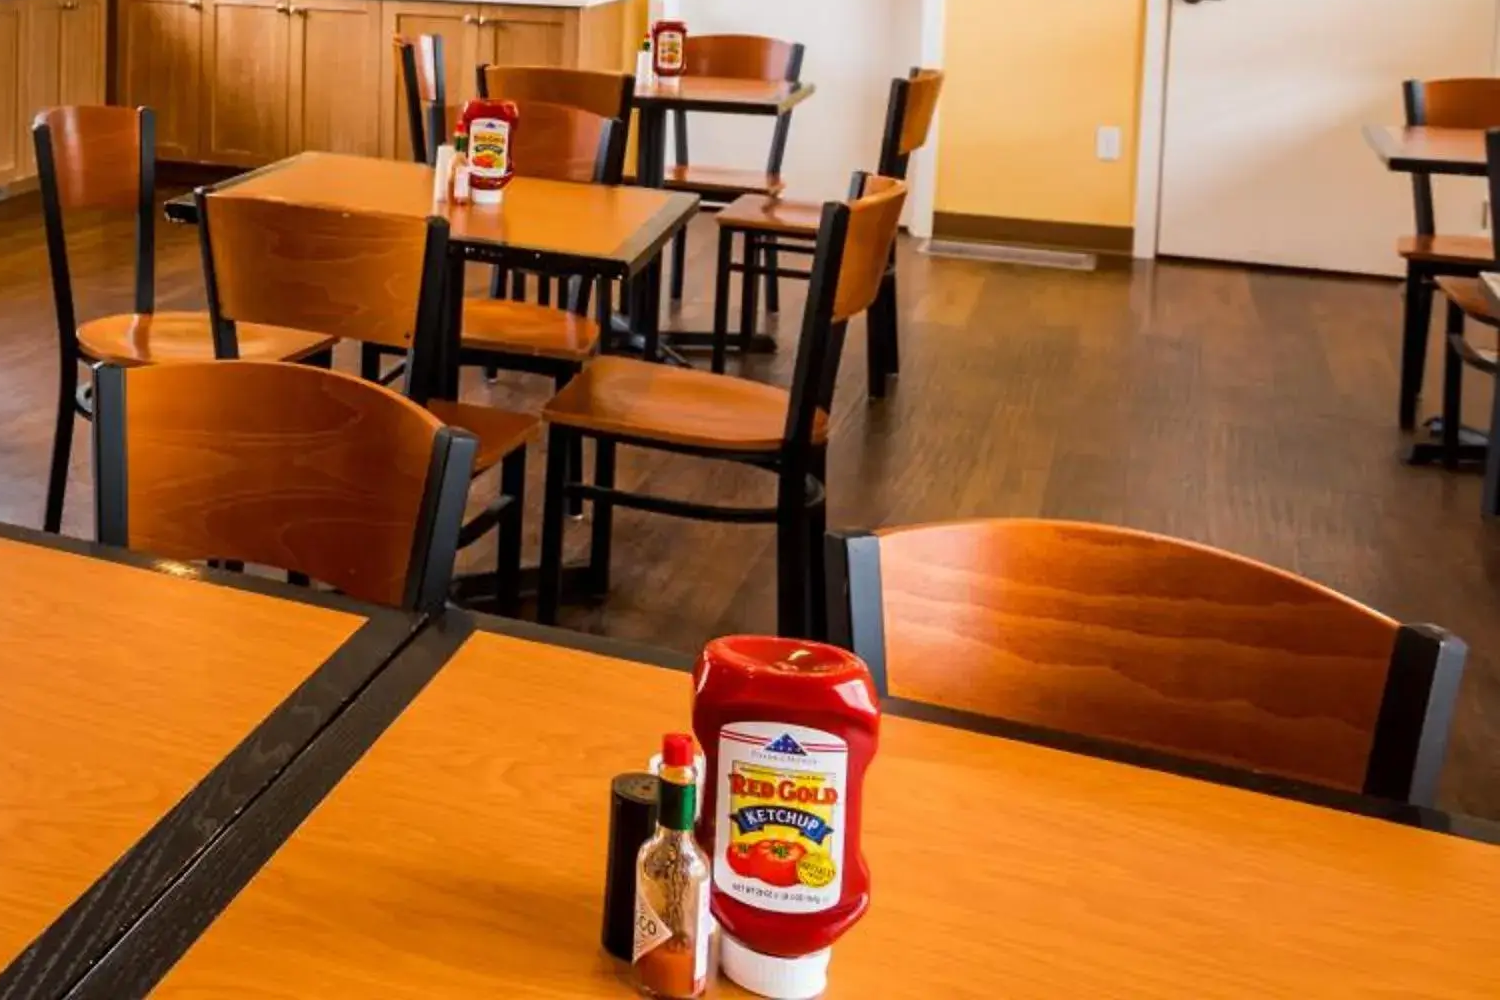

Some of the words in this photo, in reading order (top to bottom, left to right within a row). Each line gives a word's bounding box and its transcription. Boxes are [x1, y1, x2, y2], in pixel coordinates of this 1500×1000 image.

[728, 773, 775, 798] RED
[778, 780, 838, 805] GOLD
[743, 807, 820, 832] KETCHUP
